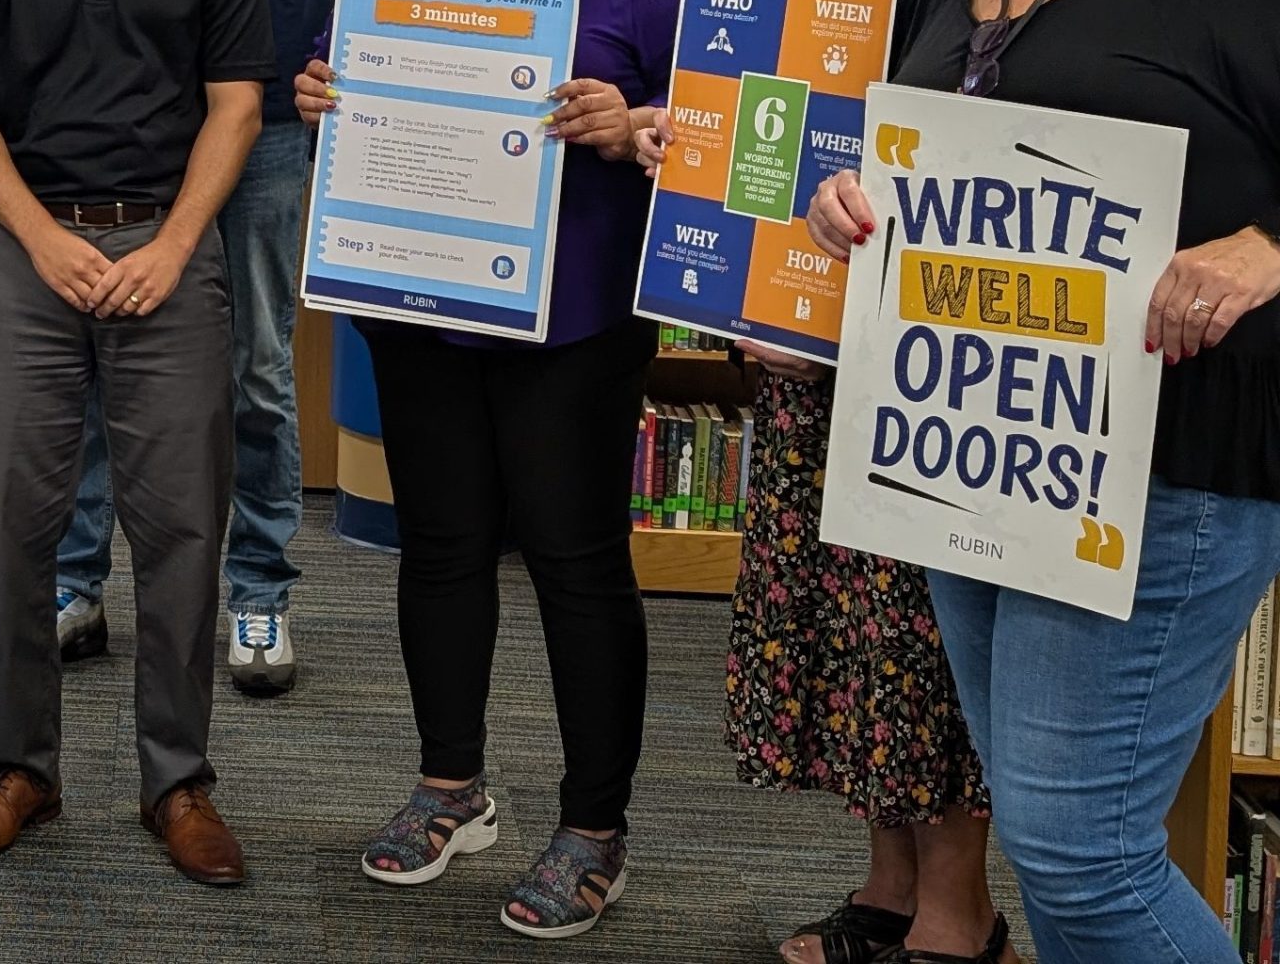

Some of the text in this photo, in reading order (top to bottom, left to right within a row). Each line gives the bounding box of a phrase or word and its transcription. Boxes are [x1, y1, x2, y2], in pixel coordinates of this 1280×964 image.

[552, 0, 562, 8] In
[816, 0, 872, 23] WHEN
[410, 4, 497, 28] 3 minutes
[359, 52, 392, 66] Step 1
[352, 113, 387, 127] Step 2
[675, 106, 723, 129] WHAT
[755, 97, 786, 141] 6
[756, 143, 777, 154] BEST
[811, 131, 863, 155] WHER
[745, 152, 784, 167] WORDS IN
[736, 163, 791, 181] NETWORKING
[892, 177, 1142, 273] WRITE
[338, 237, 373, 252] Step 3
[676, 224, 719, 250] WHY
[786, 249, 832, 275] HOW
[404, 295, 437, 309] RUBIN
[920, 260, 1087, 335] WELL
[894, 325, 1096, 435] OPEN
[872, 406, 1107, 517] DOORS!
[949, 533, 1004, 560] RUBIN
